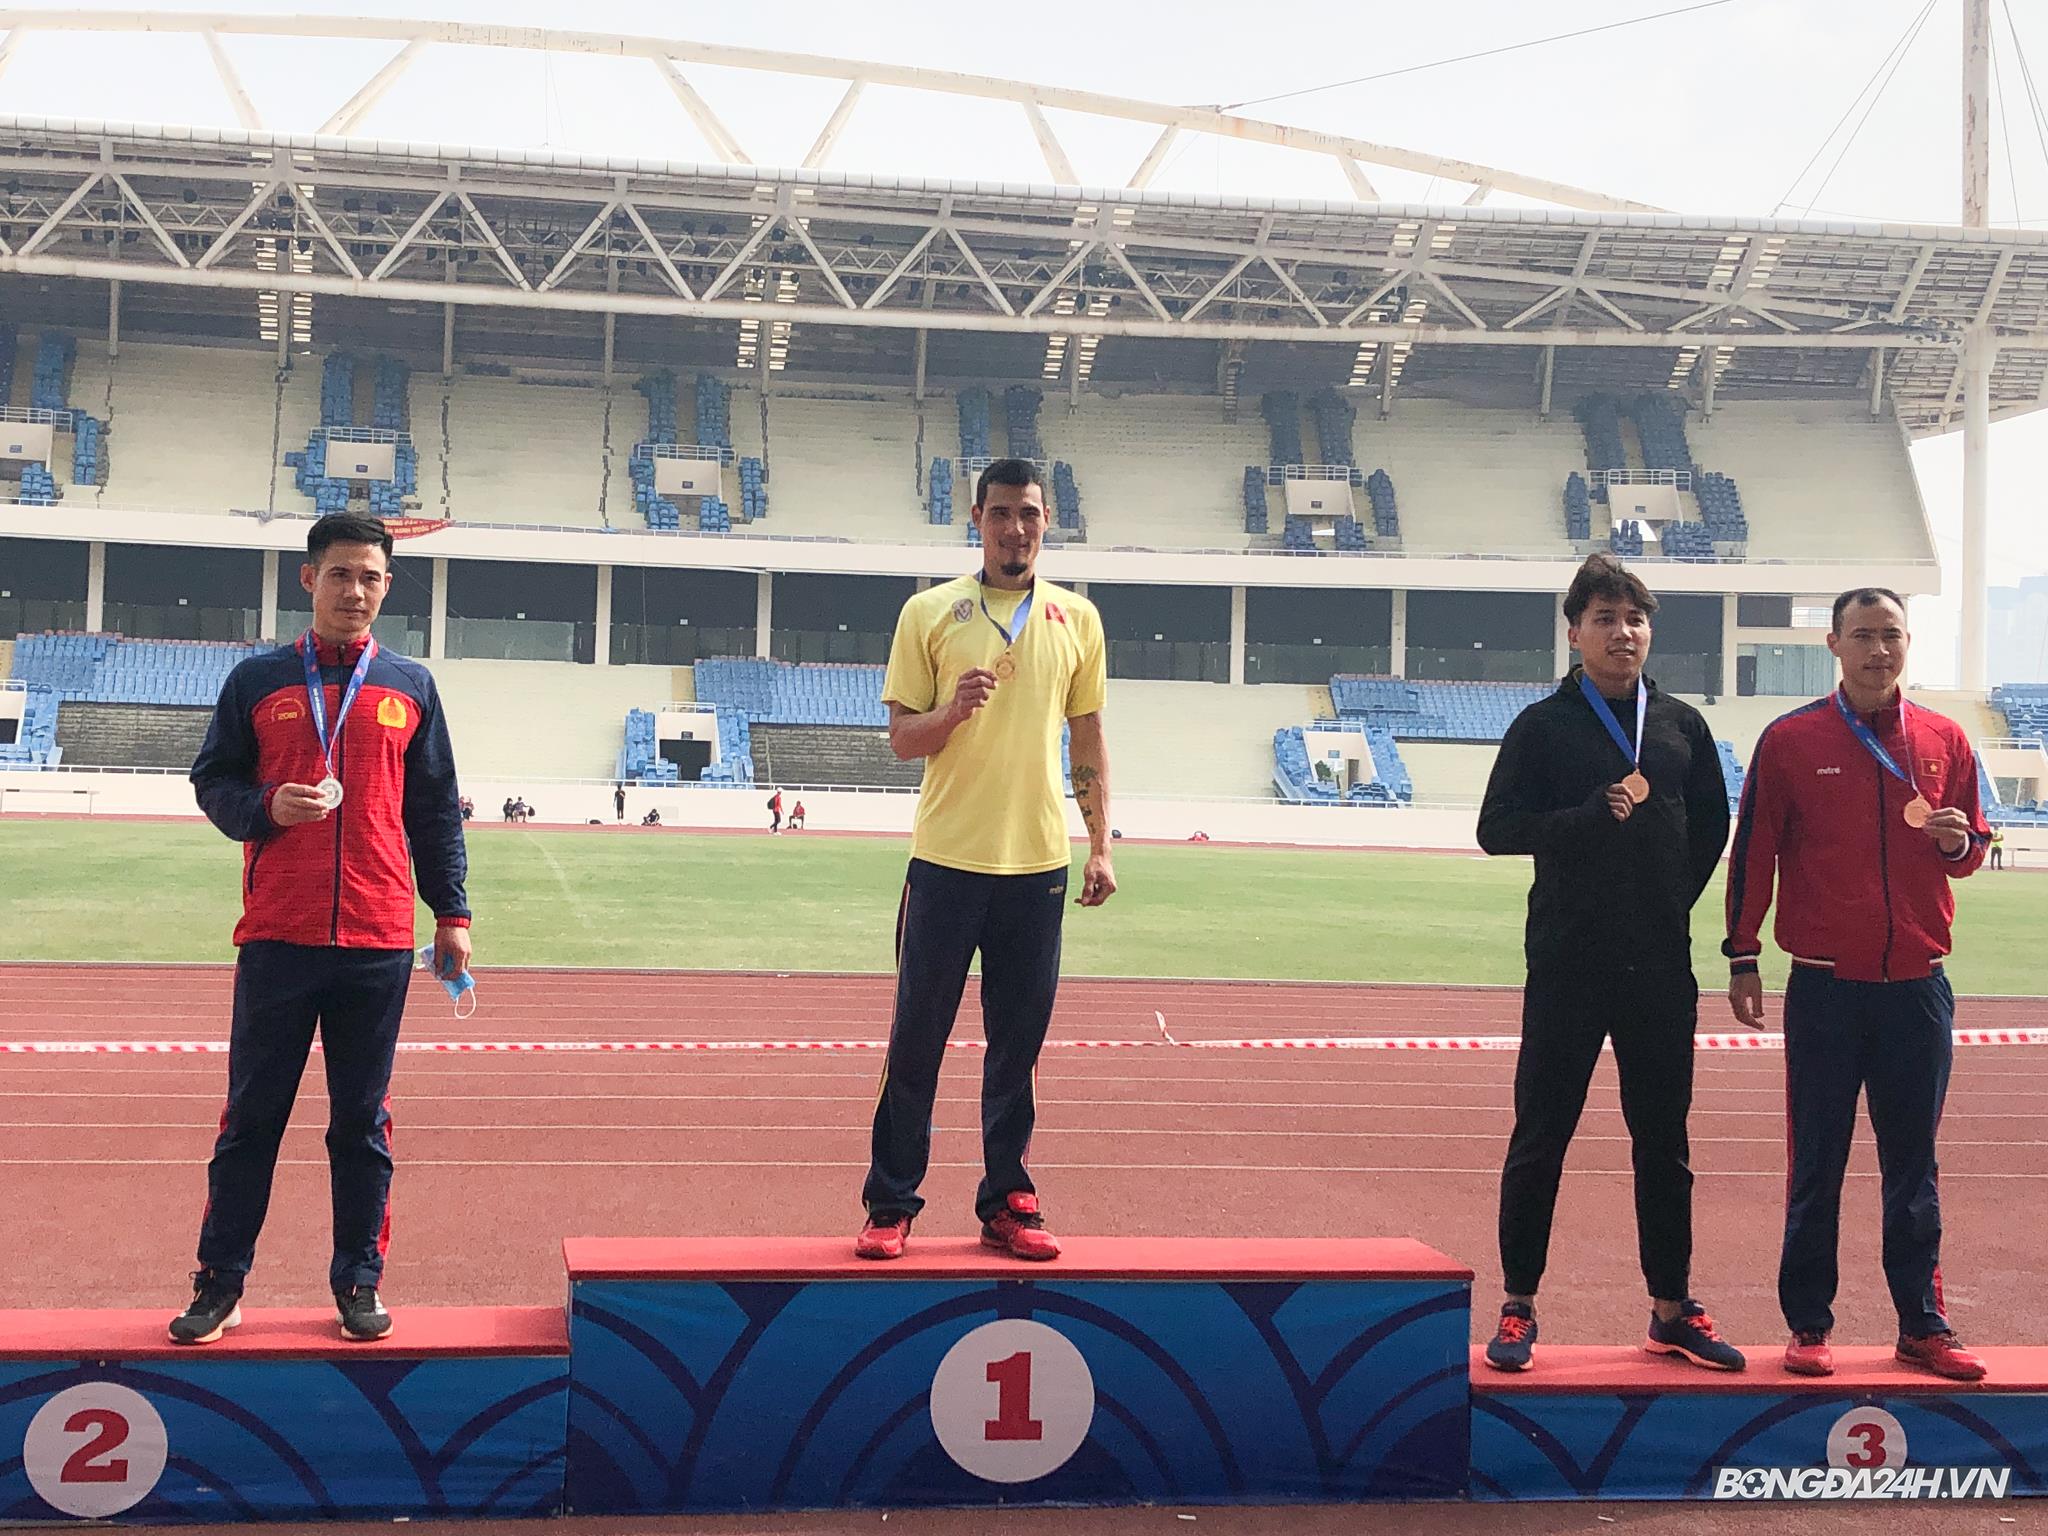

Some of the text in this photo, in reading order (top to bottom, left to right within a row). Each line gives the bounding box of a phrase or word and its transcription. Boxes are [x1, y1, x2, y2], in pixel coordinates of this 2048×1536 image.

[985, 1351, 1043, 1441] 1
[60, 1408, 130, 1483] 2
[1846, 1423, 1887, 1468] 3
